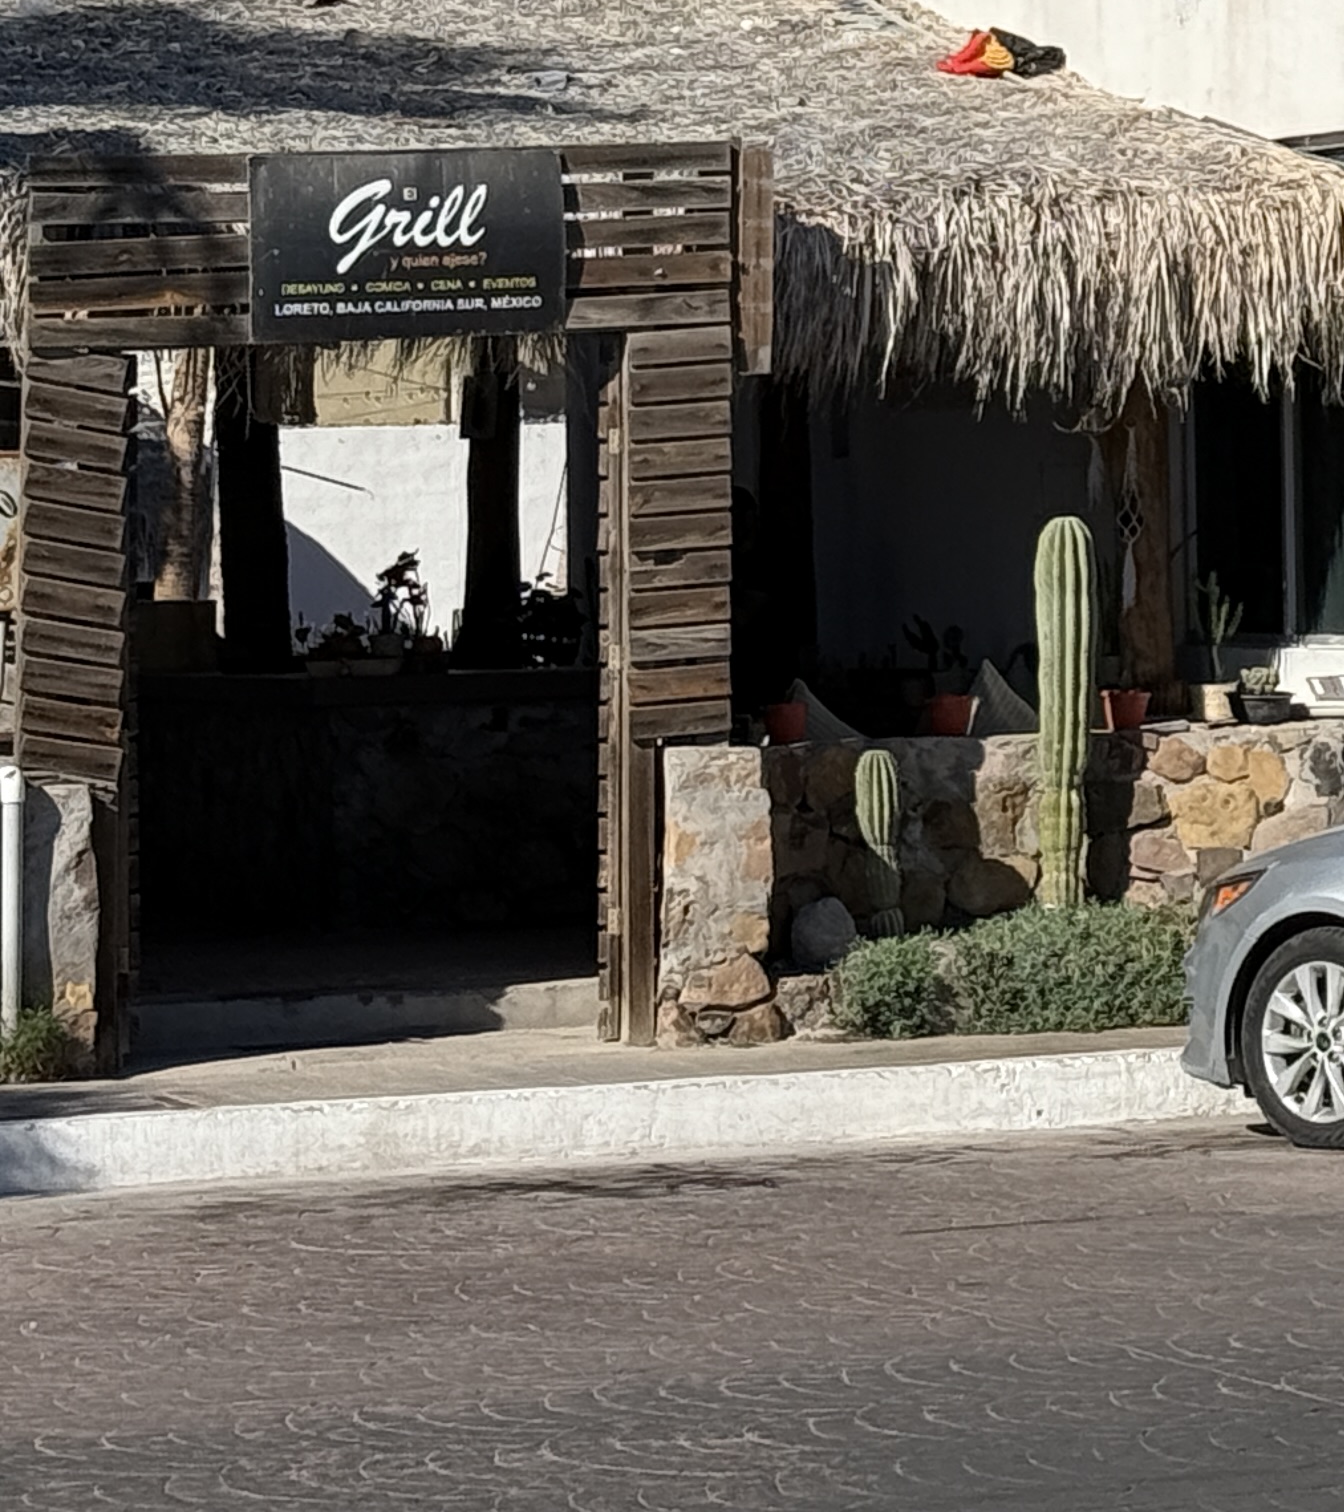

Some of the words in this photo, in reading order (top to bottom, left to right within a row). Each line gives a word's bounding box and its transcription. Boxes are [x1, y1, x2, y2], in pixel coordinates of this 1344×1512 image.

[329, 179, 488, 274] Grill
[390, 256, 399, 272] y
[402, 254, 440, 270] quien
[431, 279, 464, 291] CENA
[483, 276, 537, 290] EVENTOS
[274, 302, 334, 317] LORETO,
[336, 300, 372, 315] BAJA
[374, 298, 454, 313] CALIFORNIA
[457, 296, 487, 311] SUR,
[491, 294, 542, 310] MÉXICO
